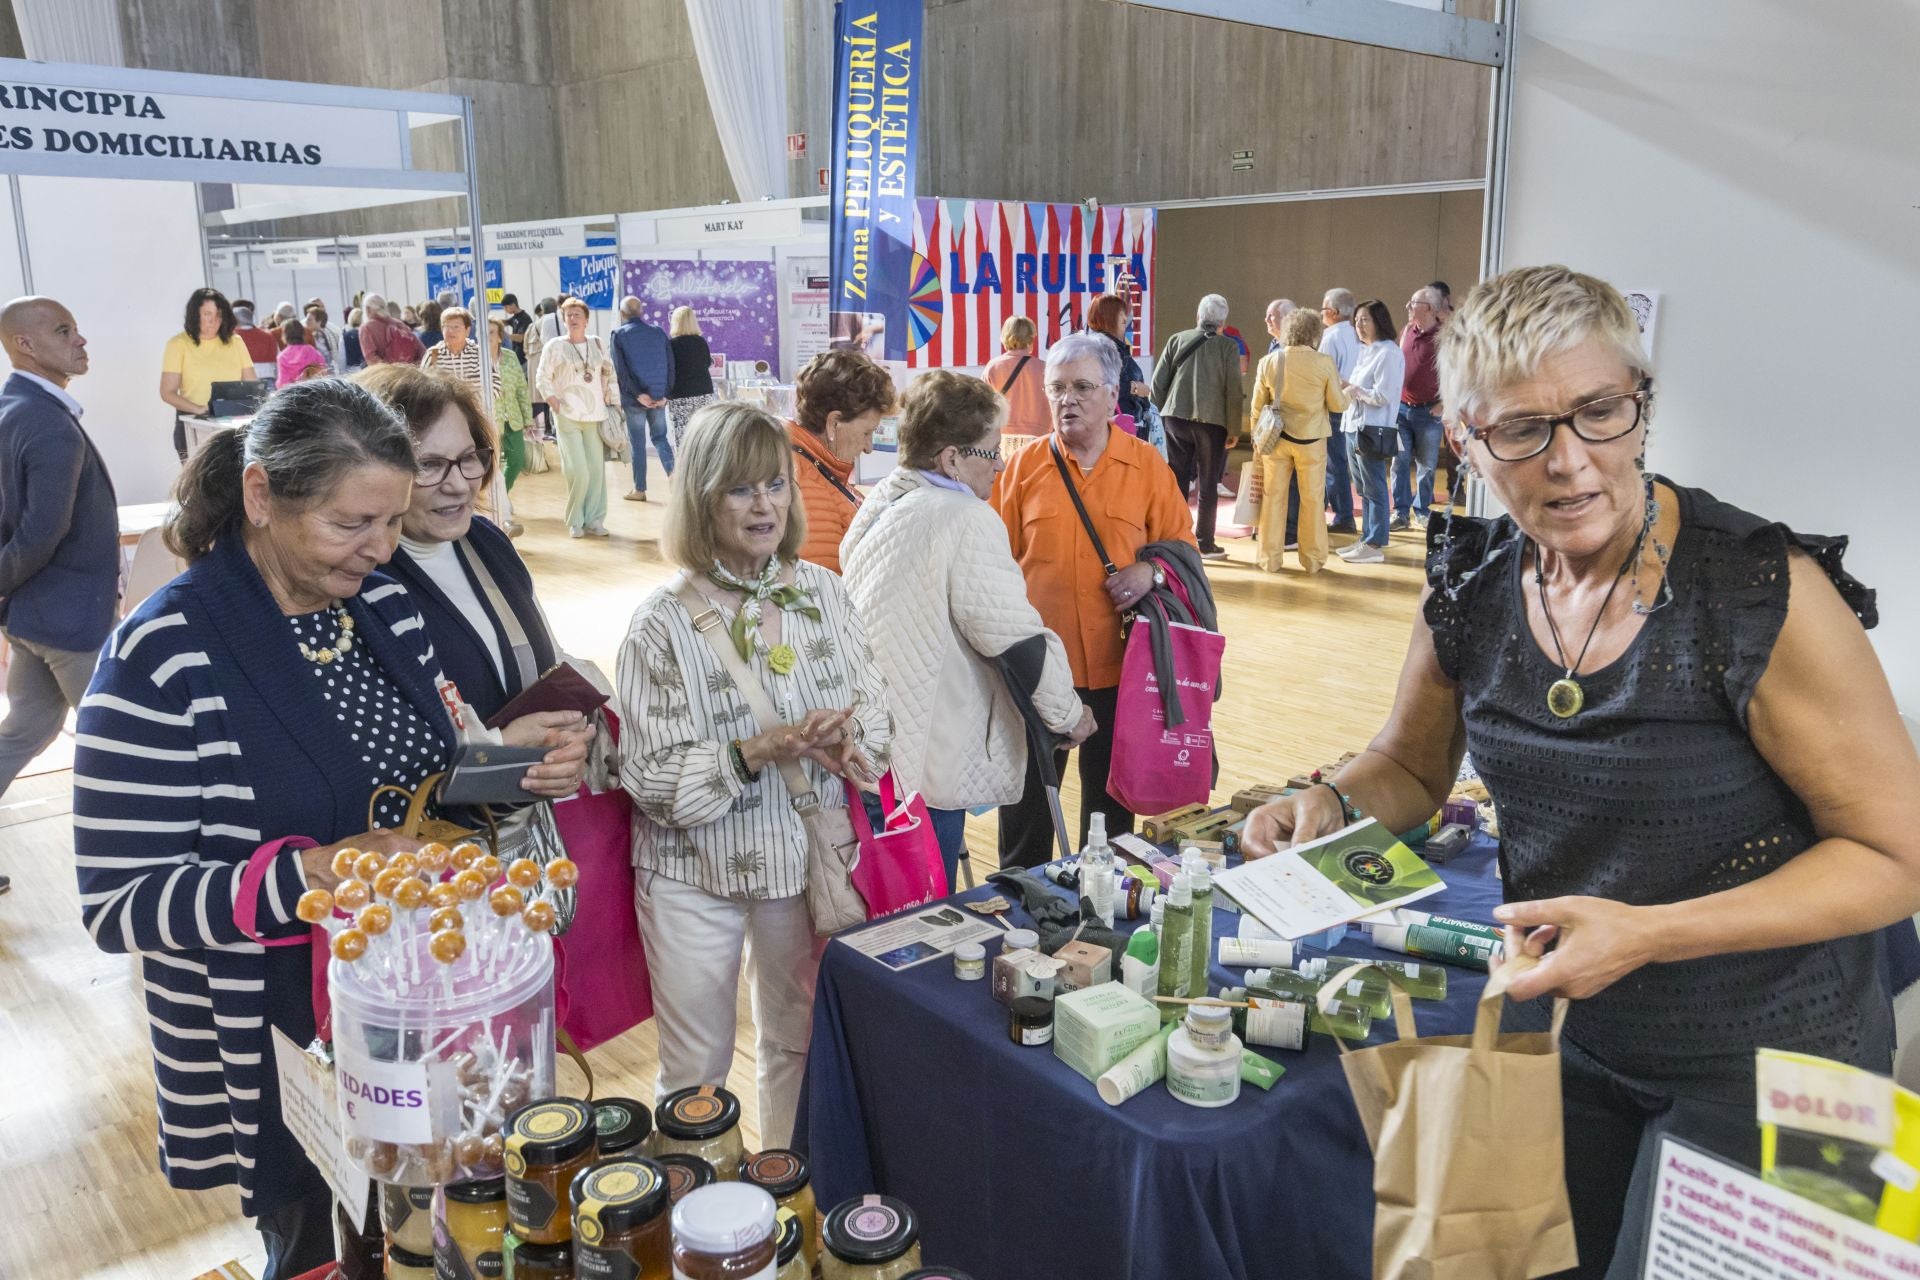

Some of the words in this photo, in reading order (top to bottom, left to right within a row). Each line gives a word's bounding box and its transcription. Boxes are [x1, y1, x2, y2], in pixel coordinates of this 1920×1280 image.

[843, 11, 881, 219] PELUQUERÍA
[42, 127, 322, 166] DOMICILIARIAS
[704, 221, 725, 233] MARY
[727, 219, 744, 232] KAY
[878, 208, 901, 223] y
[844, 226, 870, 300] Zona
[950, 252, 1001, 294] LA
[1063, 982, 1078, 992] CBD
[1769, 1088, 1878, 1126] DOLOR
[1667, 1156, 1718, 1189] Aceite
[1723, 1182, 1745, 1200] de
[1751, 1196, 1836, 1242] serpiente
[1679, 1184, 1744, 1222] castaño
[1749, 1216, 1771, 1234] de
[1676, 1202, 1738, 1241] hierbas
[1743, 1236, 1820, 1279] secretas
